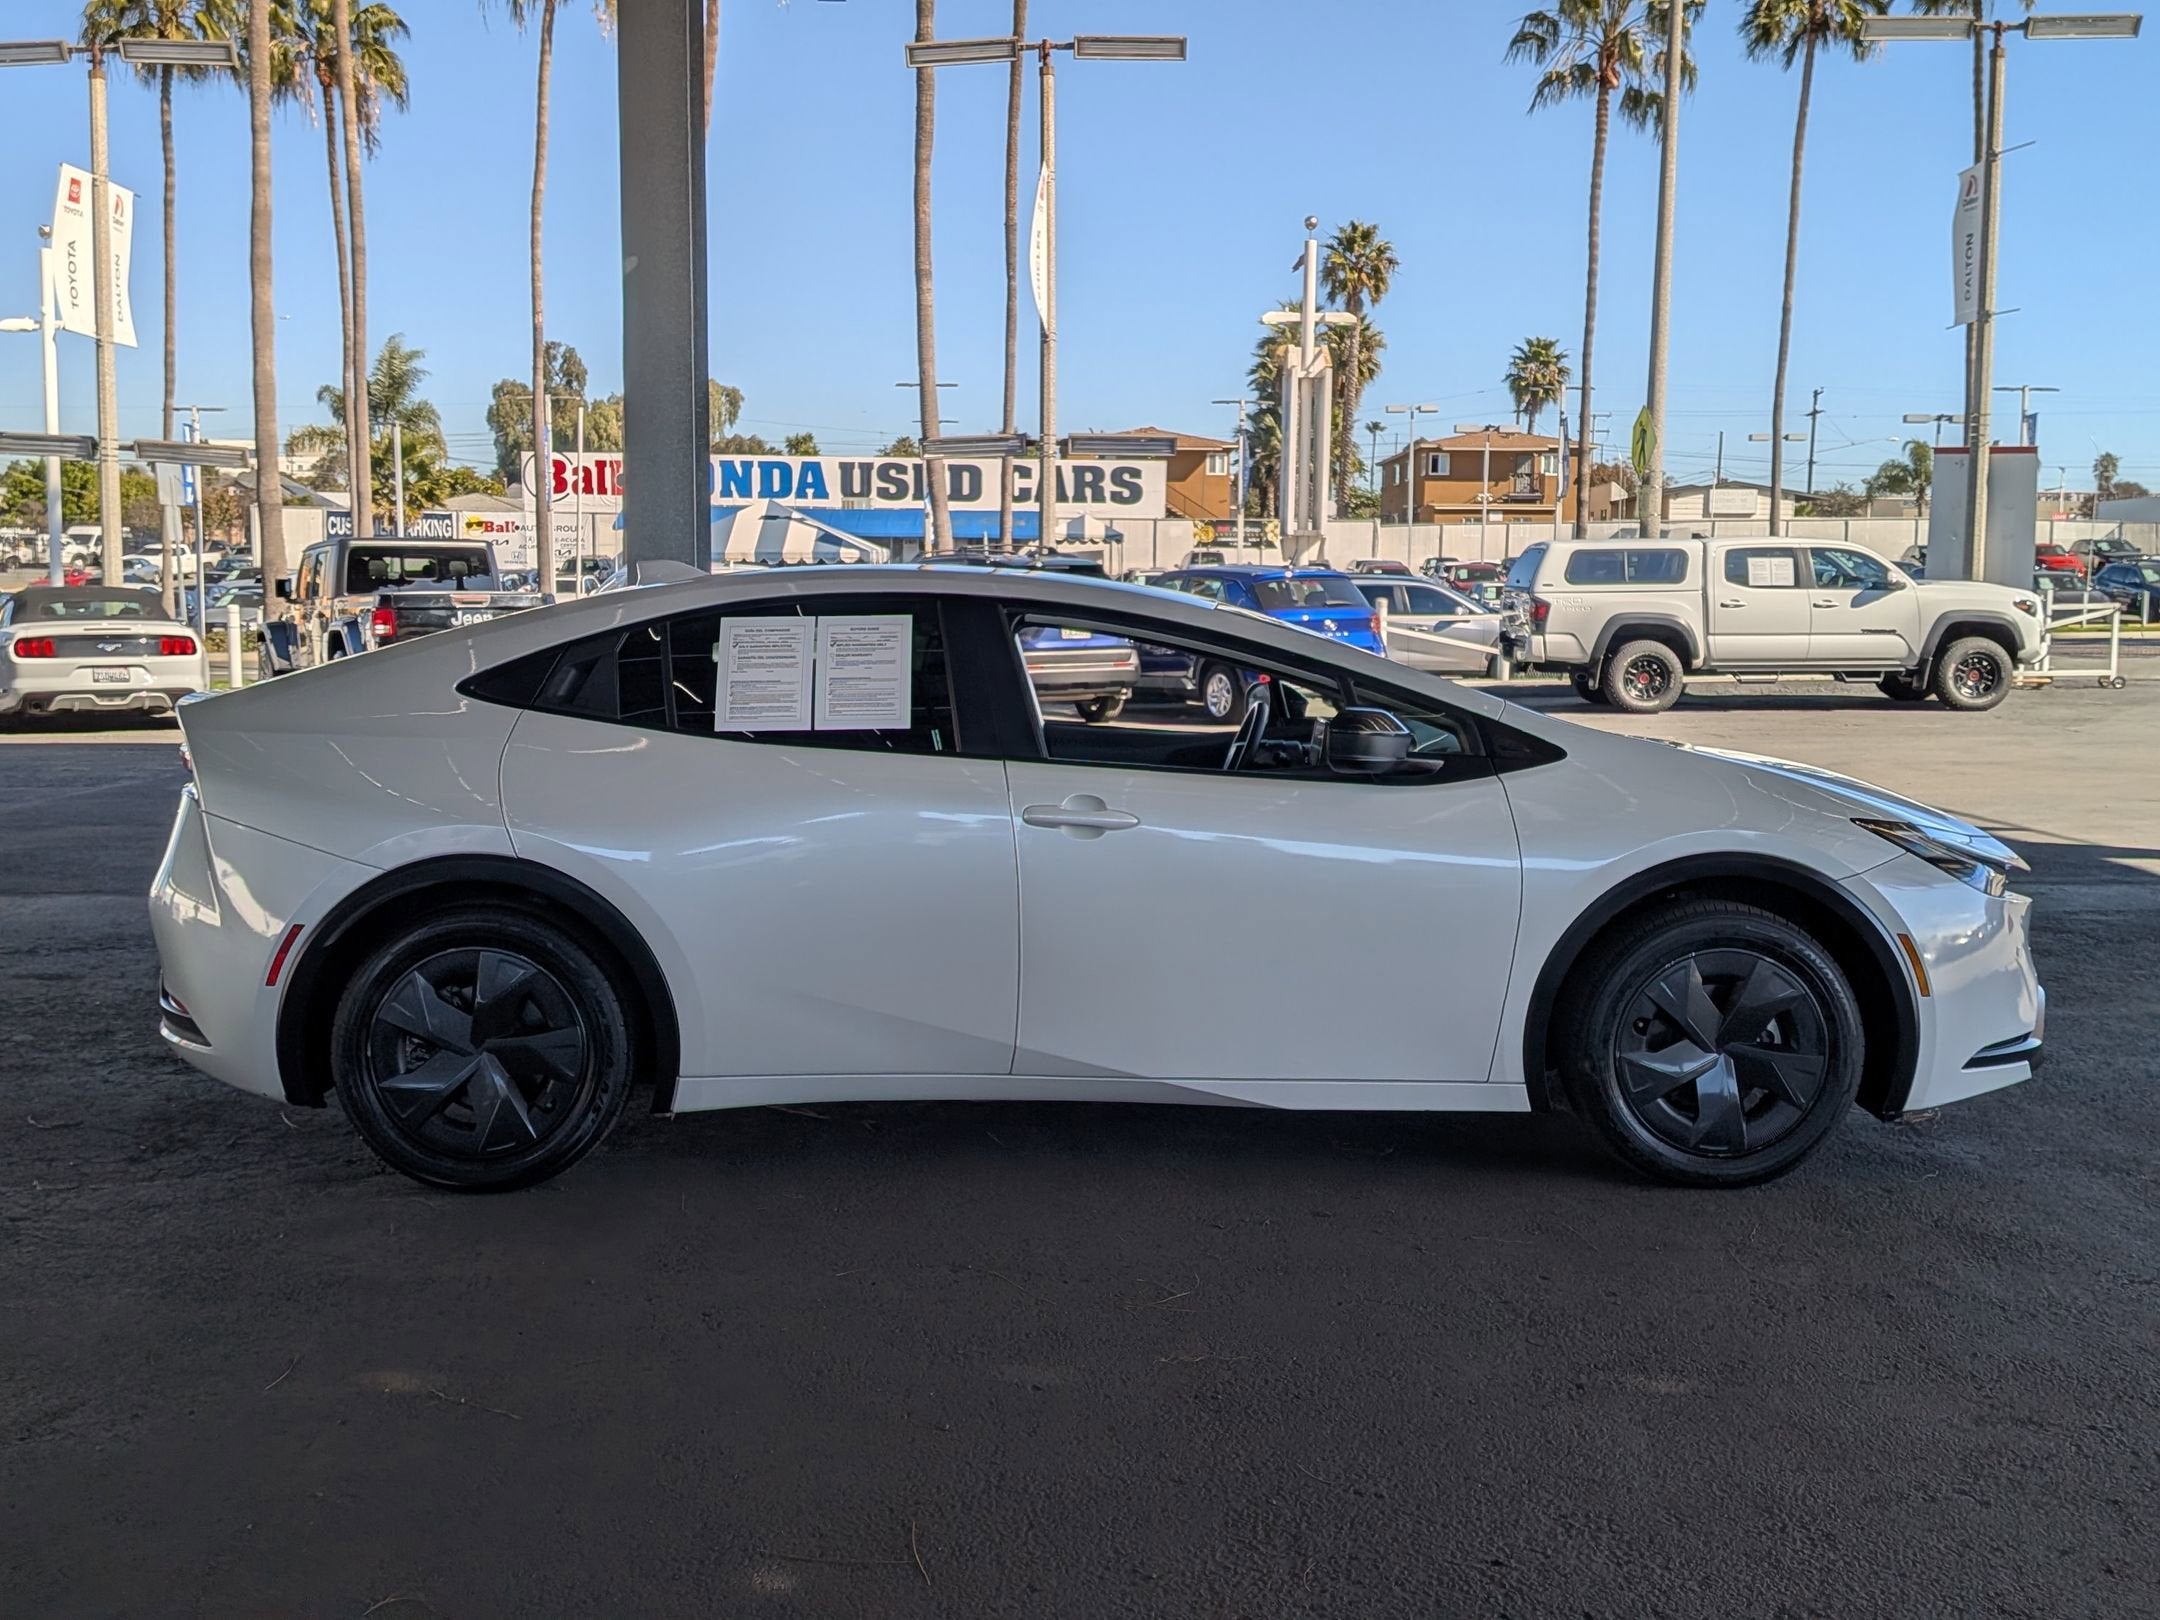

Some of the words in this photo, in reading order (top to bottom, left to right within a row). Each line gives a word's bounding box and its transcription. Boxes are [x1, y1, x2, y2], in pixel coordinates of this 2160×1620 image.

[67, 240, 79, 309] TOYOTA
[113, 254, 124, 322] DALTON
[1964, 233, 1974, 301] DALTON
[711, 460, 830, 500] NDA
[404, 519, 452, 538] ARKING
